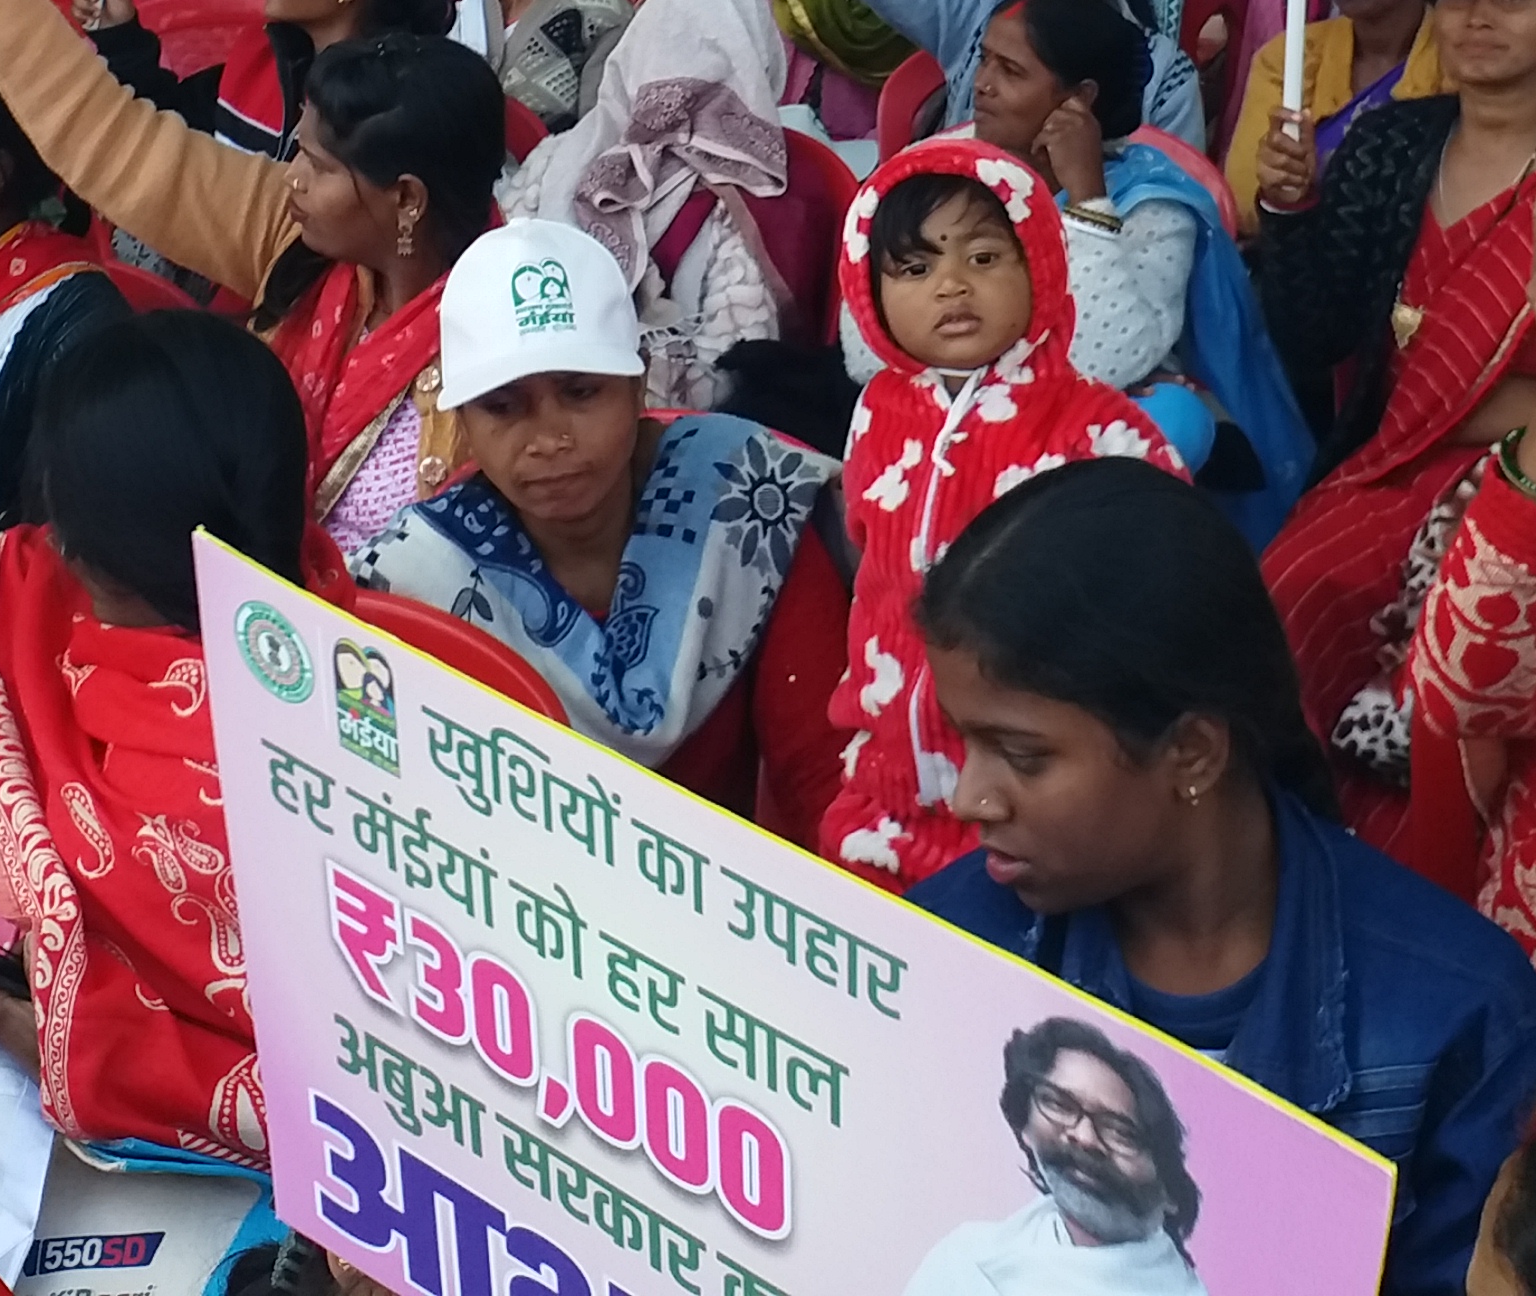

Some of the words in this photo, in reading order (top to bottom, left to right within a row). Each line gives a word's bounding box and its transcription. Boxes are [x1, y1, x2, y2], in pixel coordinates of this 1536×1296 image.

[261, 740, 335, 834] हर
[509, 880, 587, 978] को
[600, 931, 684, 1034] हर
[698, 987, 848, 1125] साल
[421, 705, 619, 863] खुशियों
[631, 819, 705, 912] का
[720, 867, 904, 1019] उपहार
[334, 1013, 482, 1156] अबुआ
[495, 1113, 706, 1294] सरकार
[335, 872, 784, 1230] ₹30,000
[44, 1237, 146, 1270] 550SD
